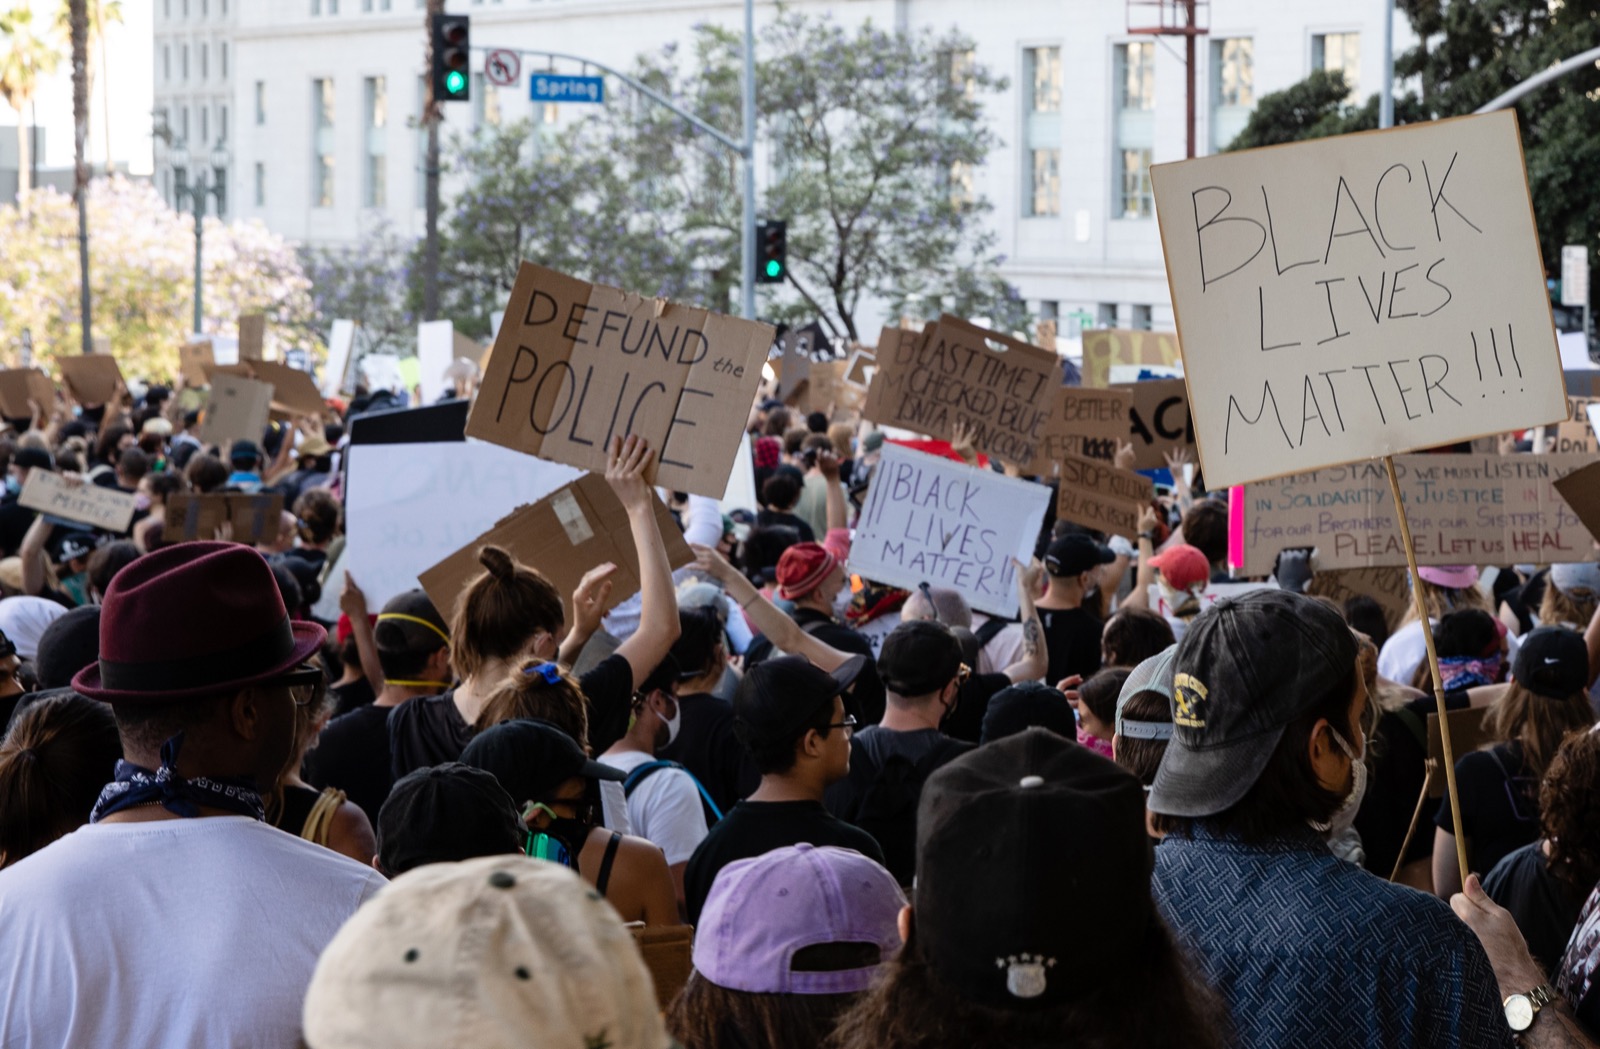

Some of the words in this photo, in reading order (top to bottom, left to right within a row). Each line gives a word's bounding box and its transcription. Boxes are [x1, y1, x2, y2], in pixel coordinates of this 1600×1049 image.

[536, 78, 599, 100] Spring
[1191, 151, 1483, 293] BLACK
[1258, 256, 1453, 352] LIVES
[523, 289, 709, 365] DEFUND
[712, 356, 744, 379] the
[916, 333, 980, 378] LAST
[977, 353, 1034, 400] TIME
[1025, 371, 1050, 405] I
[496, 344, 714, 470] POLICE
[997, 397, 1050, 440] BLUE
[1063, 396, 1123, 422] BETTER
[1064, 457, 1111, 490] STOP
[1328, 463, 1407, 484] STAND
[1415, 465, 1440, 480] WE
[1444, 466, 1482, 480] MUST
[1484, 459, 1550, 480] LISTEN
[892, 462, 981, 522] BLACK
[1060, 489, 1106, 522] BLACK
[1255, 498, 1272, 511] IN
[1278, 485, 1385, 511] SOLIDARITY
[1415, 481, 1504, 505] JUSTICE
[1523, 488, 1538, 503] IN
[1476, 505, 1548, 529] SISTERS
[904, 510, 998, 565] LIVES
[1334, 533, 1435, 558] PLEAE,
[1438, 530, 1477, 555] LET
[1481, 540, 1505, 554] US
[1512, 529, 1573, 551] HEAL
